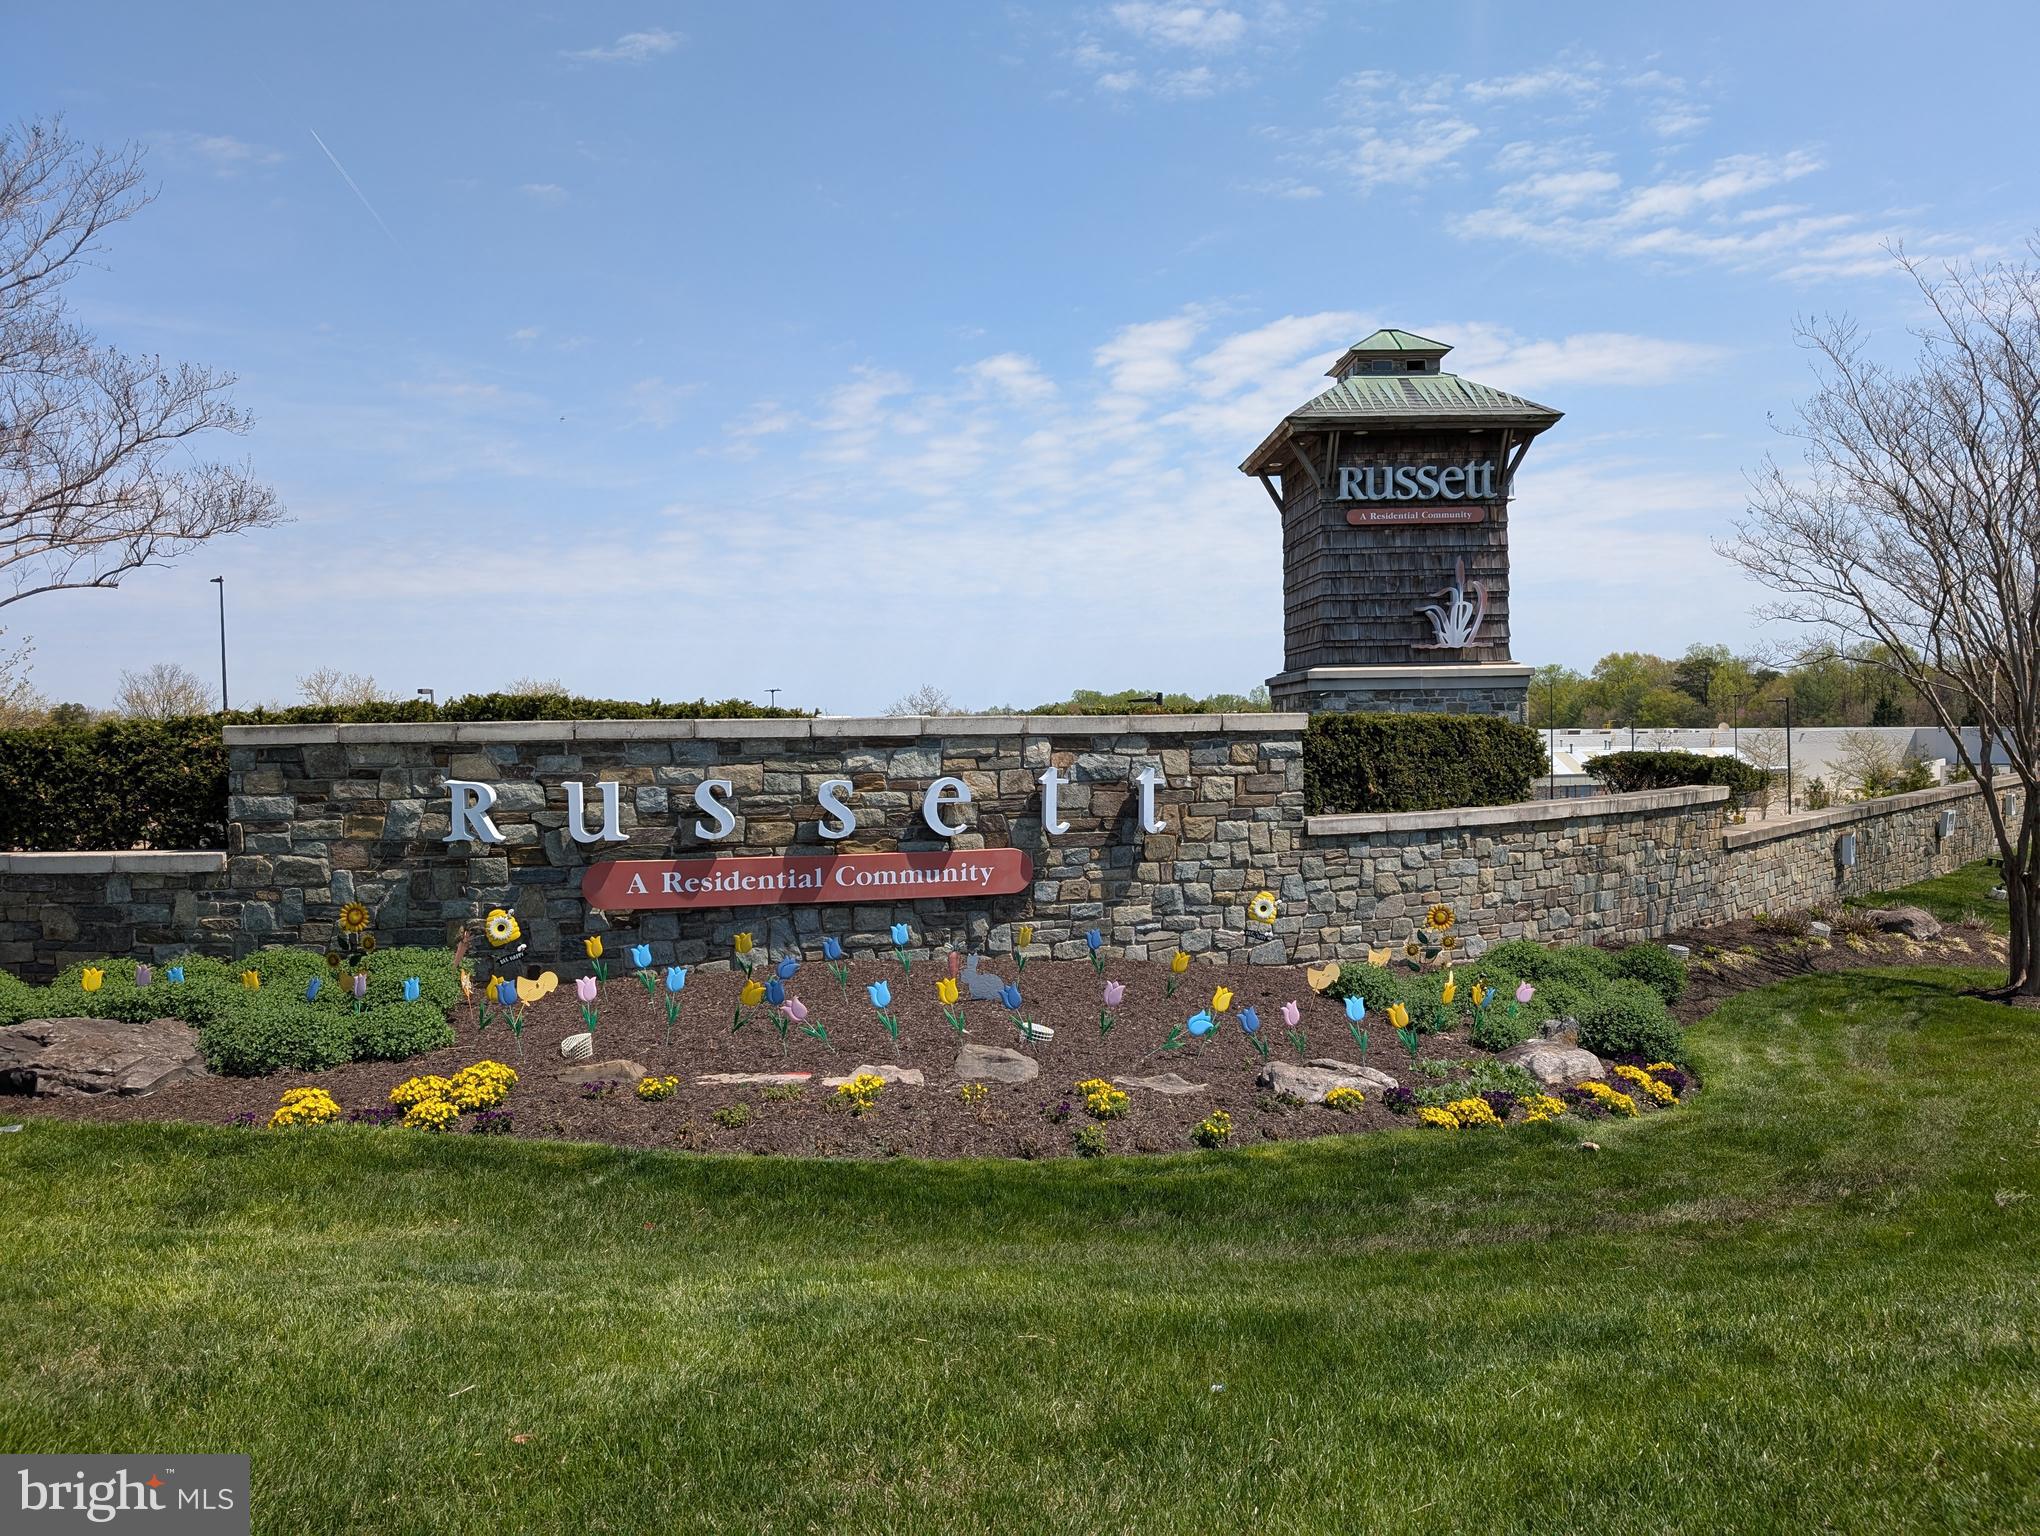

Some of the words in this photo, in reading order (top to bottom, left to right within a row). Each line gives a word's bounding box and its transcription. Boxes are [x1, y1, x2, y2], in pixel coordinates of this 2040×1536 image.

[1336, 460, 1498, 501] Russett
[1360, 512, 1367, 520] A
[1370, 511, 1419, 521] Residential
[1421, 510, 1473, 521] Community
[626, 871, 649, 895] A
[661, 867, 824, 894] Residential
[835, 861, 995, 888] Community
